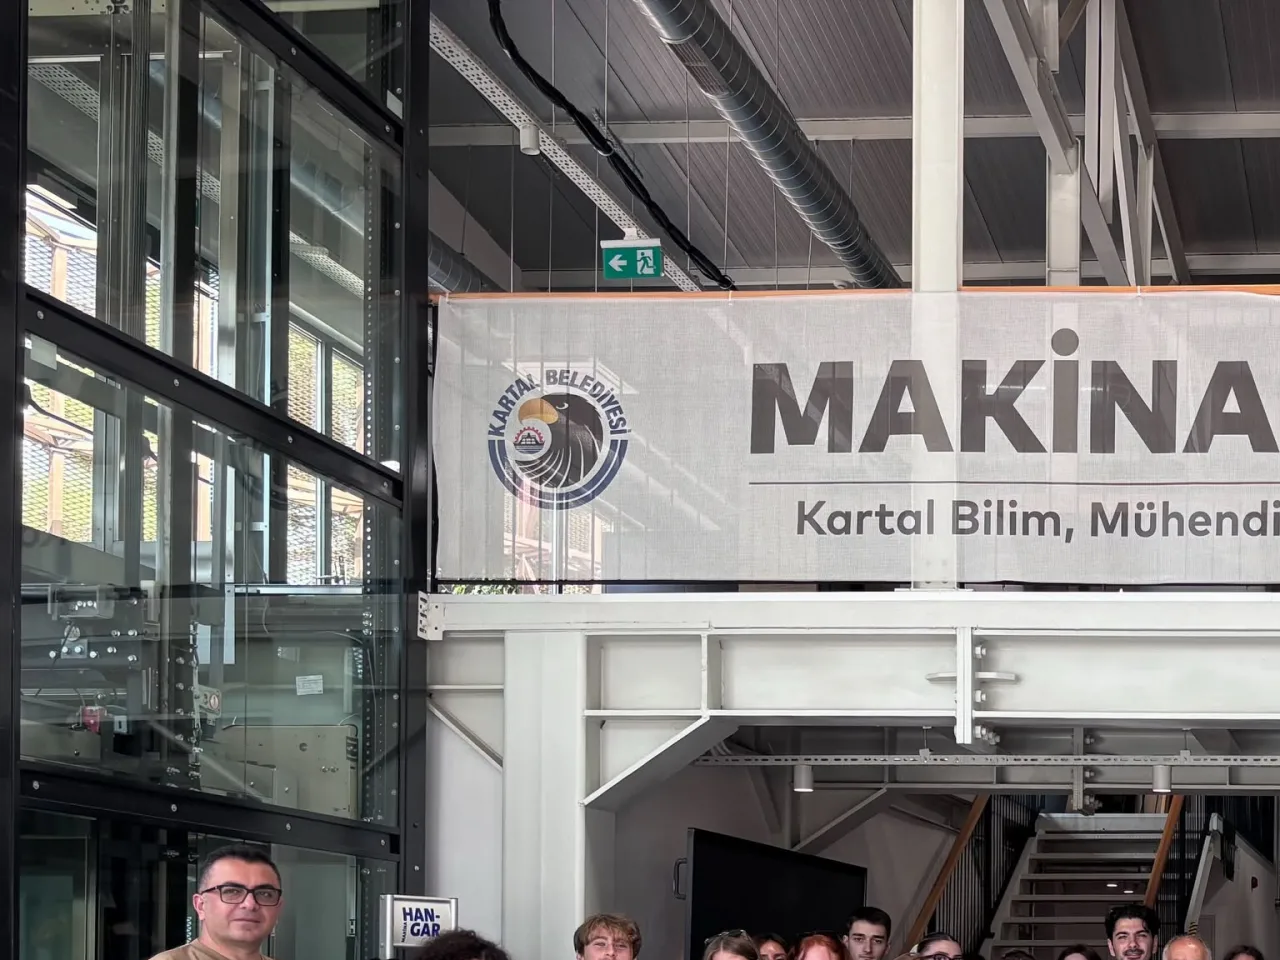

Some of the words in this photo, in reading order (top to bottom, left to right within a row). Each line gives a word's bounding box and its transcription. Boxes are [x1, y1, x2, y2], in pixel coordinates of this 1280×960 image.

[488, 373, 541, 437] KARTAL
[545, 369, 632, 435] BELEDİYESİ
[750, 327, 1280, 454] MAKİNA
[796, 499, 935, 536] Kartal
[952, 498, 1074, 543] Bilim,
[402, 907, 440, 922] HAN-
[410, 922, 440, 938] GAR
